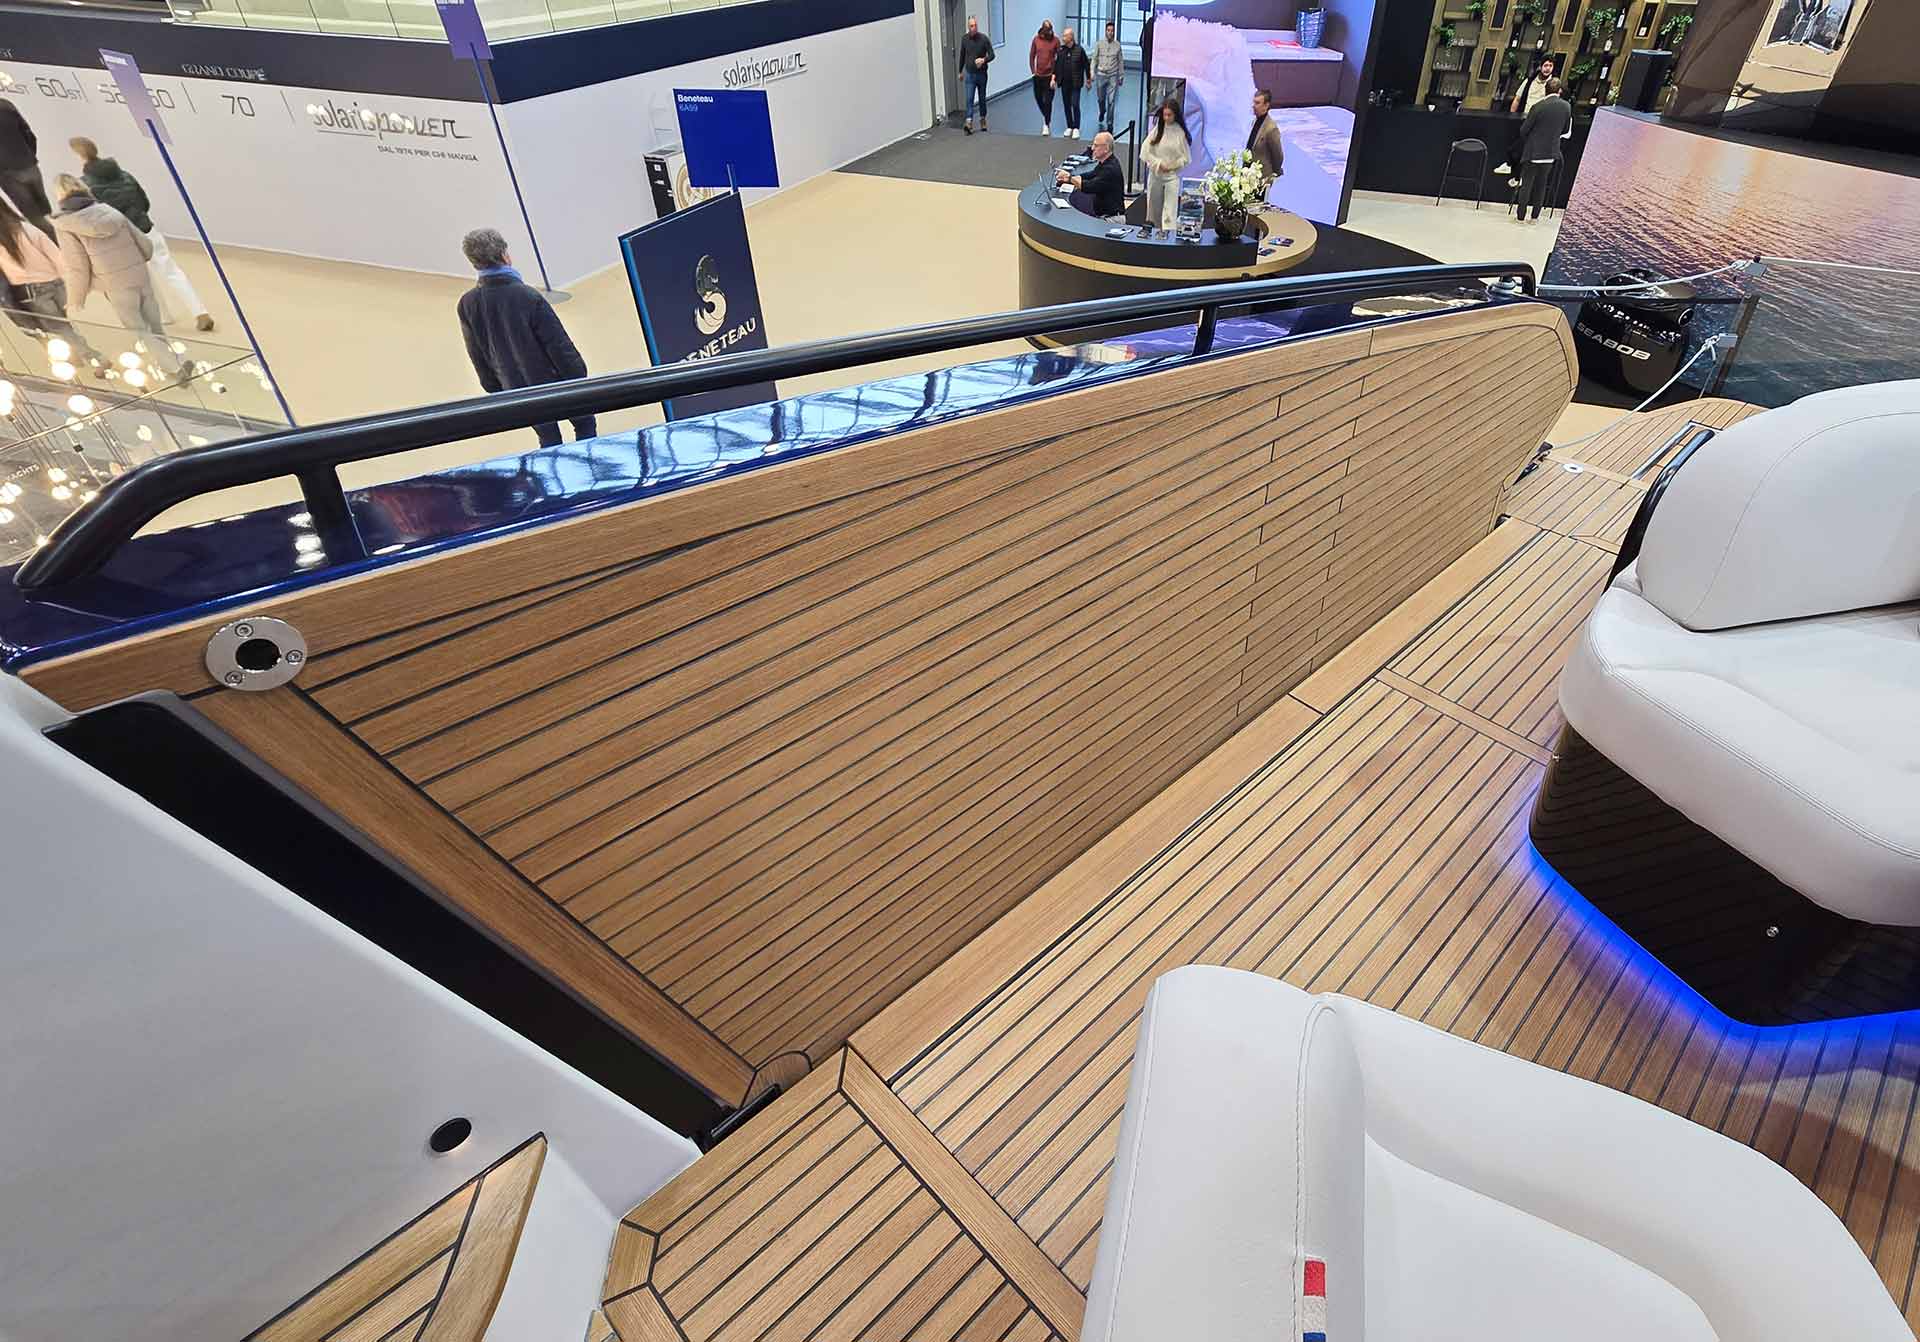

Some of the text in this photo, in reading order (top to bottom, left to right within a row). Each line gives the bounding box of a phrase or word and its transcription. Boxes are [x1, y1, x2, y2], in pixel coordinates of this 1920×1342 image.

[221, 94, 256, 117] 70
[677, 94, 714, 103] Beneteau
[1576, 322, 1651, 360] SEABOB
